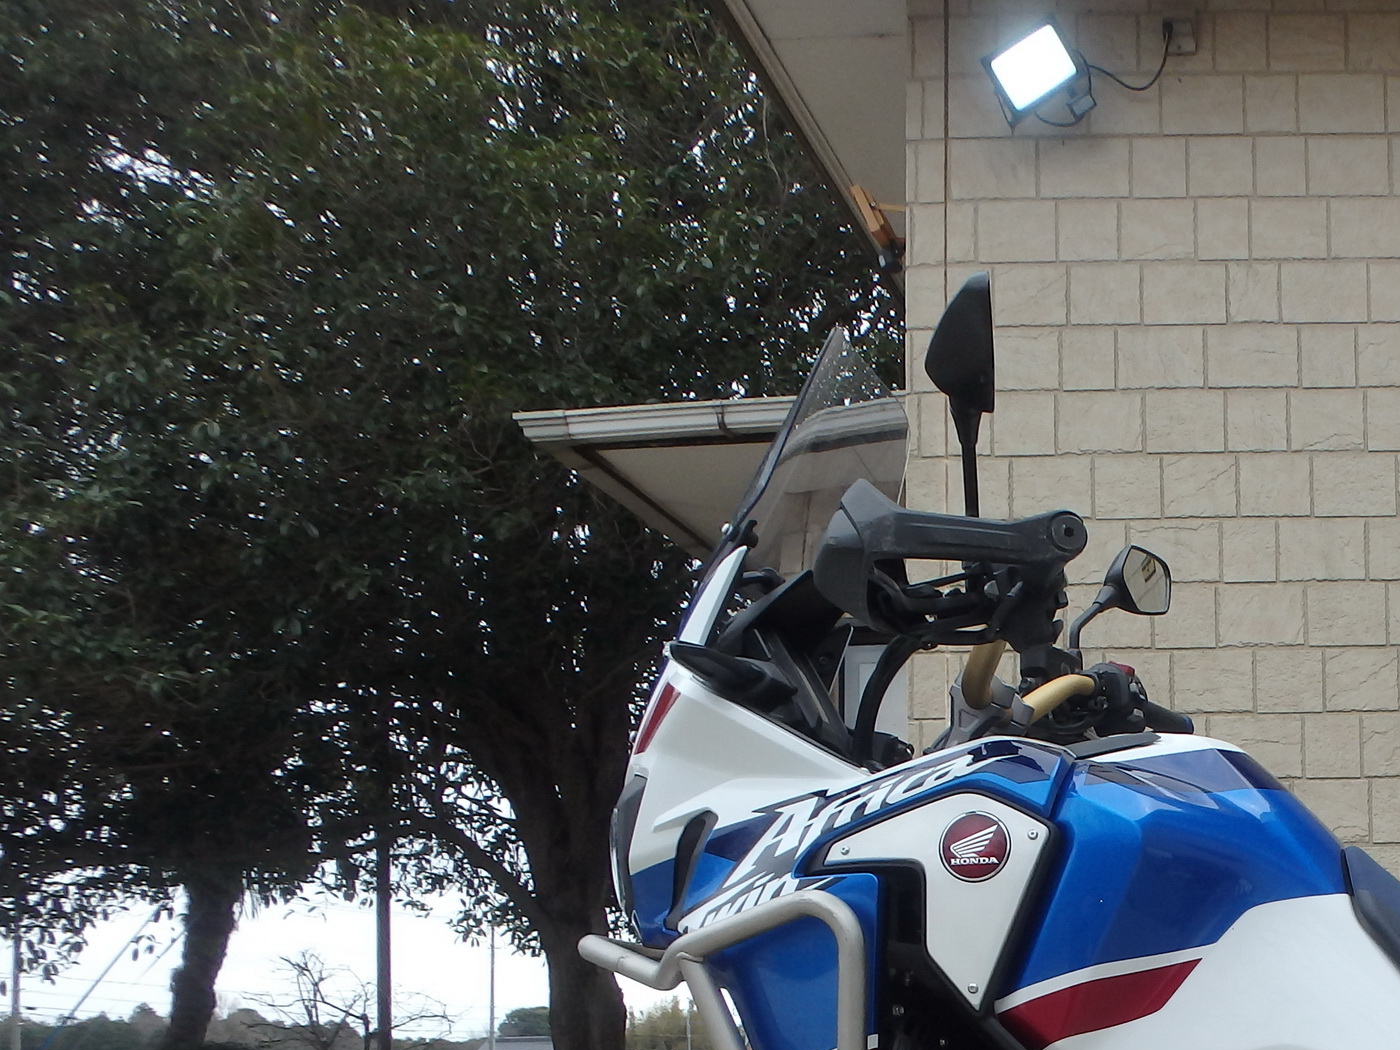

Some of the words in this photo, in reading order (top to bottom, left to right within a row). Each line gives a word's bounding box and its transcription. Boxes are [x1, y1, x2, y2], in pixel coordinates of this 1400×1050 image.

[723, 754, 1019, 889] Africa
[950, 856, 999, 866] HONDA
[677, 870, 836, 936] Twin
